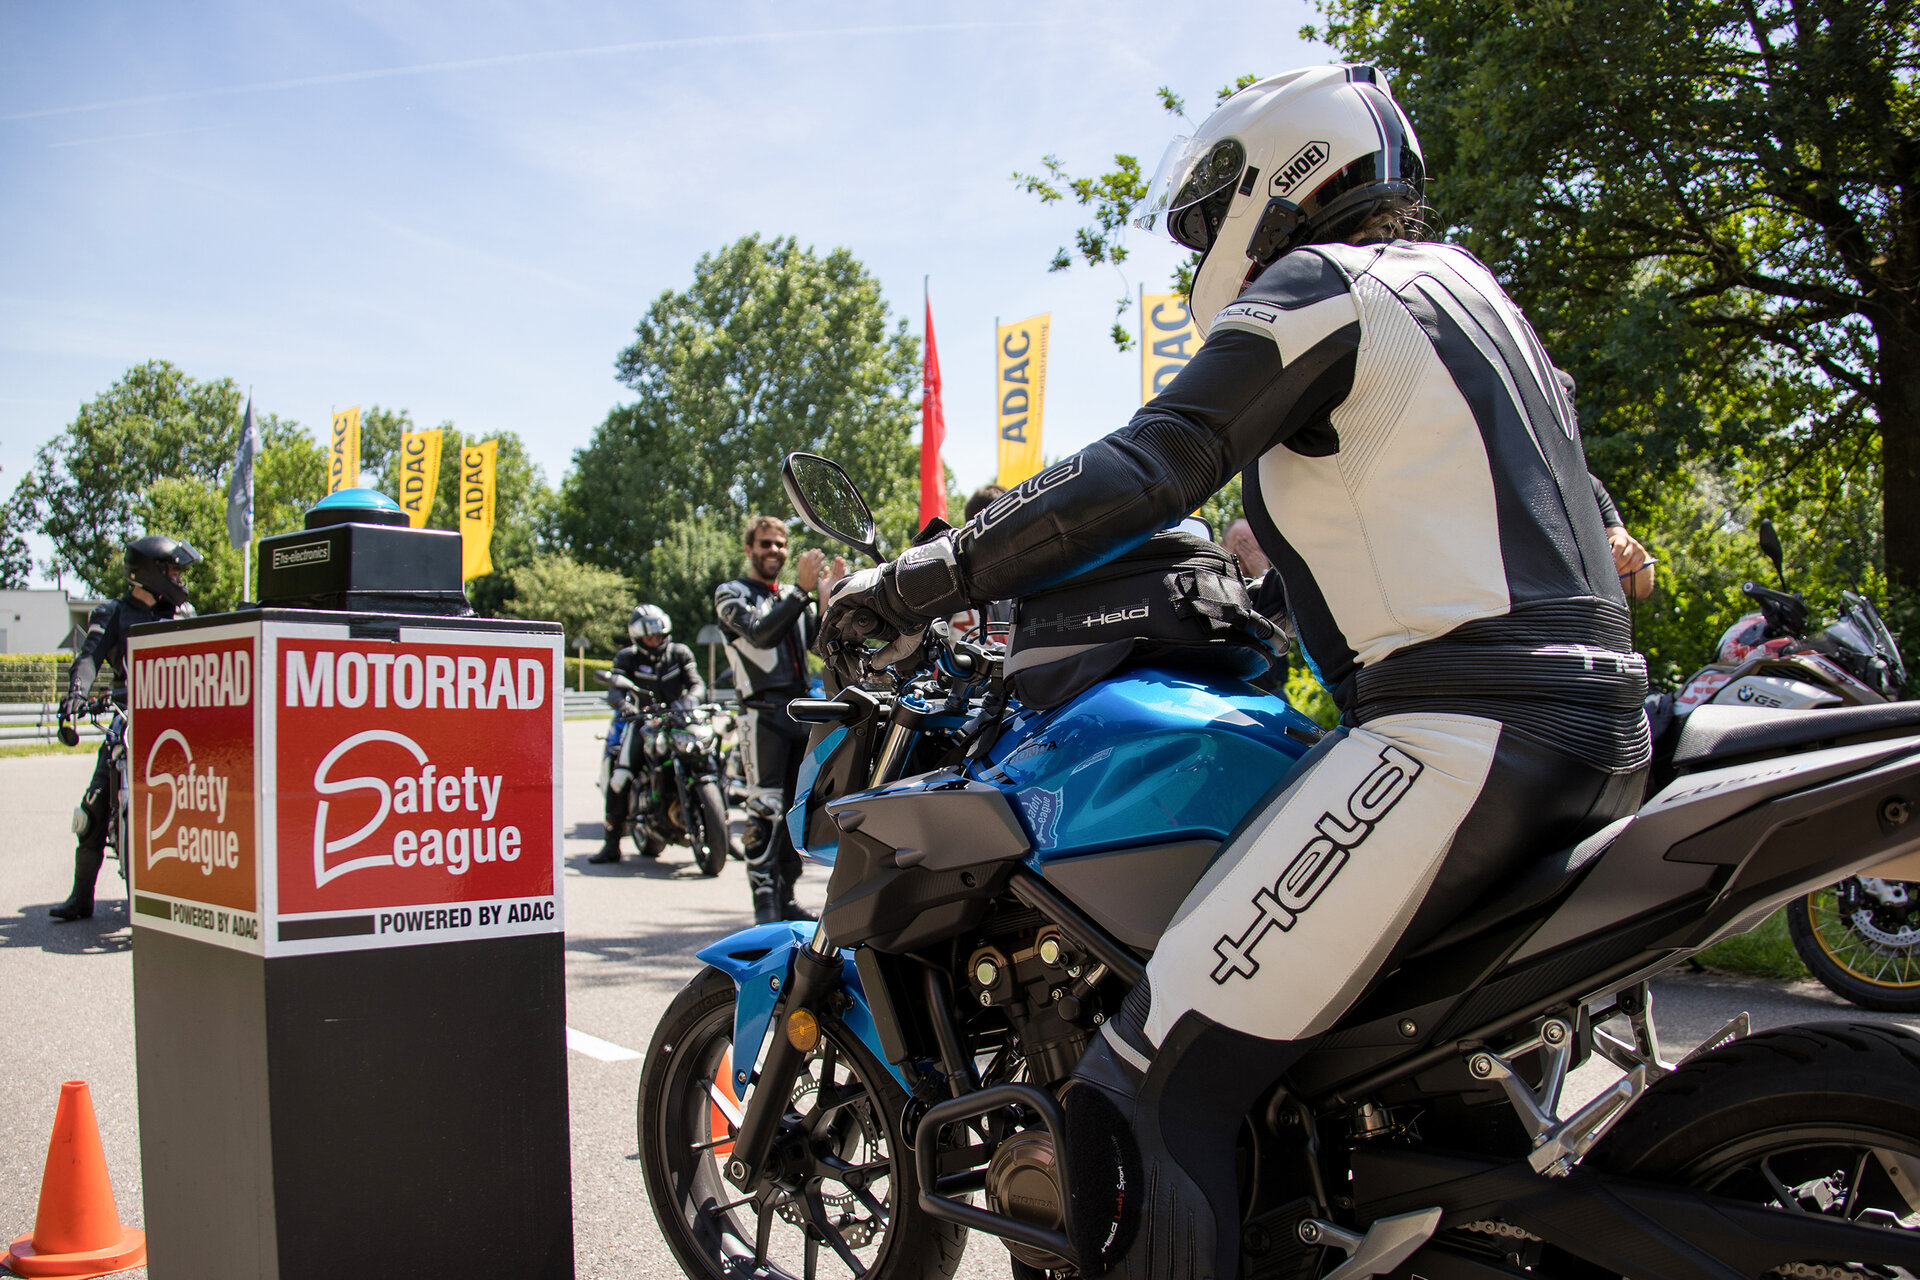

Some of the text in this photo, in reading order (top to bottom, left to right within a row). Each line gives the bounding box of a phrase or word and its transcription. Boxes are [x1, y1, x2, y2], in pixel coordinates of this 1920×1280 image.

[1274, 145, 1325, 193] SHOEI
[1001, 329, 1030, 443] ADAC
[331, 416, 347, 493] ADAC
[406, 438, 425, 512] ADAC
[465, 451, 484, 521] ADAC
[957, 453, 1084, 554] Held
[1082, 605, 1149, 628] Held
[135, 650, 250, 709] MOTORRAD
[285, 650, 545, 710] MOTORRAD
[1754, 695, 1782, 708] GS
[146, 728, 228, 840] Safety
[314, 729, 502, 853] Safety
[146, 793, 239, 876] League
[313, 800, 521, 889] League
[1210, 745, 1425, 985] Held
[173, 902, 258, 940] POWERED BY ADAC
[380, 901, 555, 934] POWERED BY ADAC
[1101, 1222, 1118, 1253] Held
[1117, 1165, 1126, 1190] Sport
